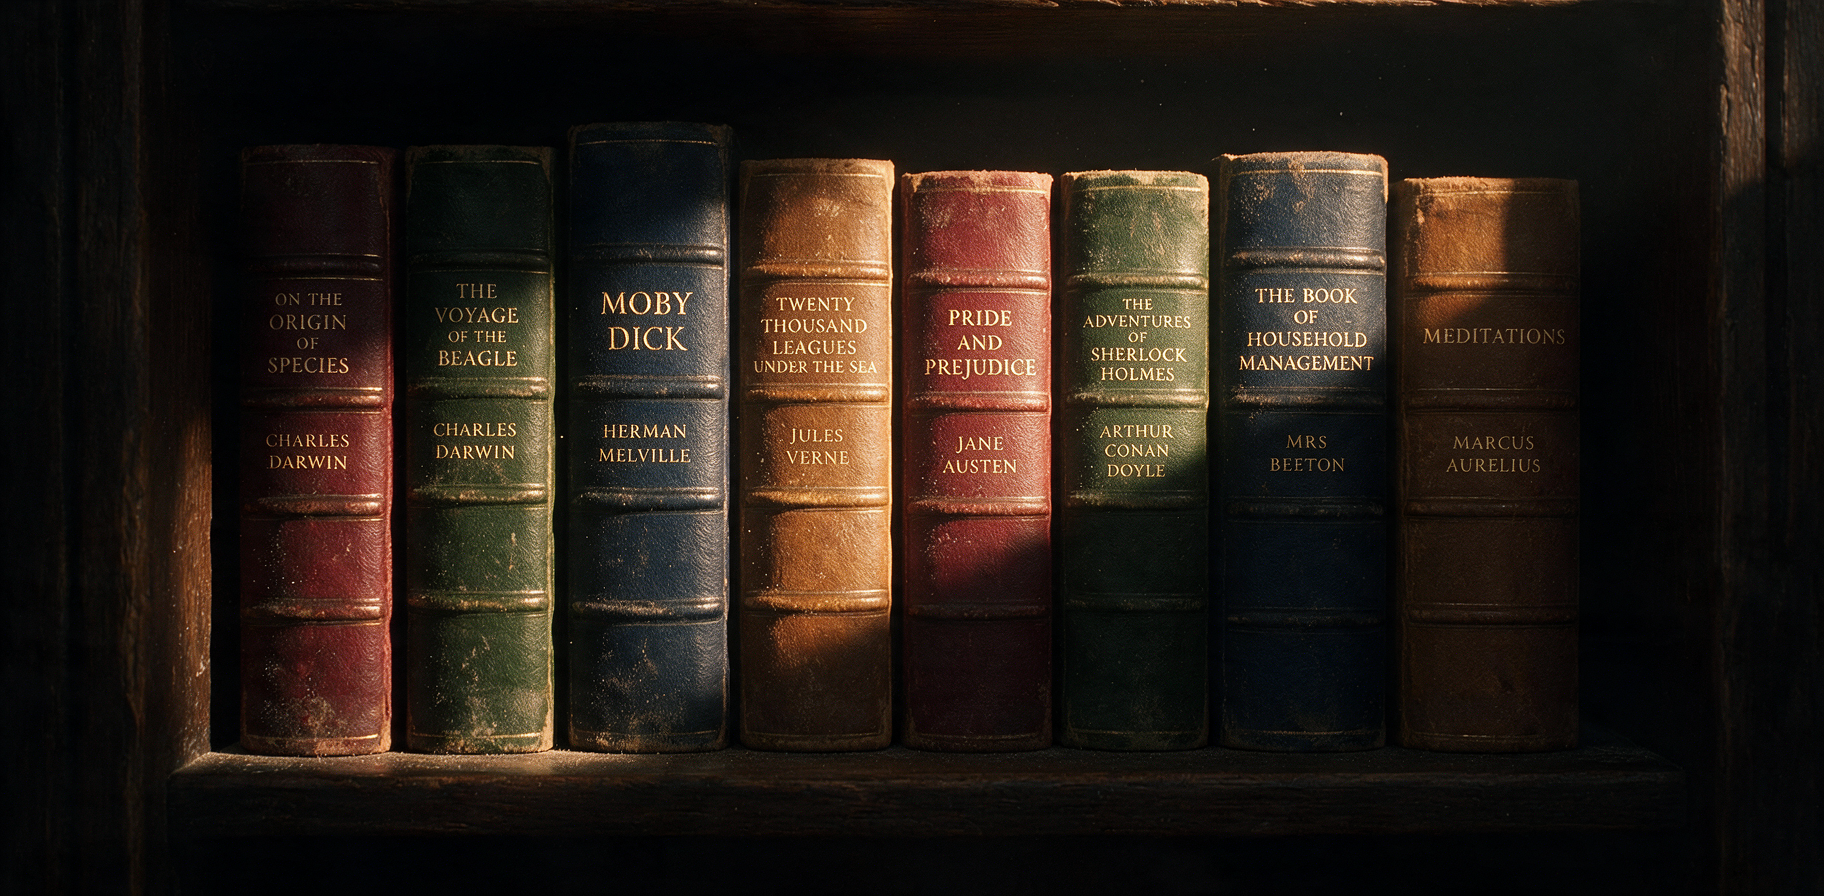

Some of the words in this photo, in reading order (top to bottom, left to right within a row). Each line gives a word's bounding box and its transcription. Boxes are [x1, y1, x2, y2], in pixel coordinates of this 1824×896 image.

[274, 292, 300, 306] ON
[307, 292, 343, 306] THE
[455, 283, 498, 299] THE
[1254, 287, 1296, 304] THE
[1302, 287, 1358, 304] BOOK
[600, 291, 694, 316] MOBY
[775, 296, 855, 312] TWENTY
[1121, 297, 1154, 311] THE
[269, 314, 347, 331] ORIGIN
[434, 306, 519, 324] VOYAGE
[948, 309, 1013, 327] PRIDE
[1082, 314, 1191, 329] ADVENTURES
[1293, 309, 1319, 325] OF
[760, 318, 868, 334] THOUSAND
[296, 337, 320, 350] OF
[447, 330, 469, 343] OF
[473, 330, 507, 343] THE
[608, 326, 688, 351] DICK
[957, 334, 1003, 351] AND
[1127, 331, 1148, 343] OF
[1246, 331, 1368, 348] HOUSEHOLD
[1422, 327, 1565, 345] MEDITATIONS
[772, 339, 857, 355] LEAGUES
[1090, 346, 1188, 363] SHERLOCK
[267, 357, 350, 374] SPECIES
[438, 350, 518, 367] BEAGLE
[1238, 355, 1375, 371] MANAGEMENT
[753, 360, 809, 374] UNDER
[812, 360, 845, 374] THE
[848, 360, 878, 374] SEA
[924, 358, 1037, 380] PREJUDICE
[1100, 366, 1175, 382] HOLMES
[433, 422, 517, 438] CHARLES
[603, 423, 687, 439] HERMAN
[789, 427, 843, 445] JULES
[1099, 424, 1176, 439] ARTHUR
[265, 433, 350, 448] CHARLES
[955, 435, 1004, 454] JANE
[1285, 434, 1327, 449] MRS
[1452, 435, 1534, 451] MARCUS
[435, 444, 515, 460] DARWIN
[598, 448, 691, 463] MELVILLE
[785, 450, 850, 466] VERNE
[1104, 443, 1169, 458] CONAN
[269, 455, 347, 470] DARWIN
[942, 459, 1017, 474] AUSTEN
[1107, 463, 1166, 478] DOYLE
[1269, 457, 1345, 472] BEETON
[1445, 458, 1541, 473] AURELIUS
